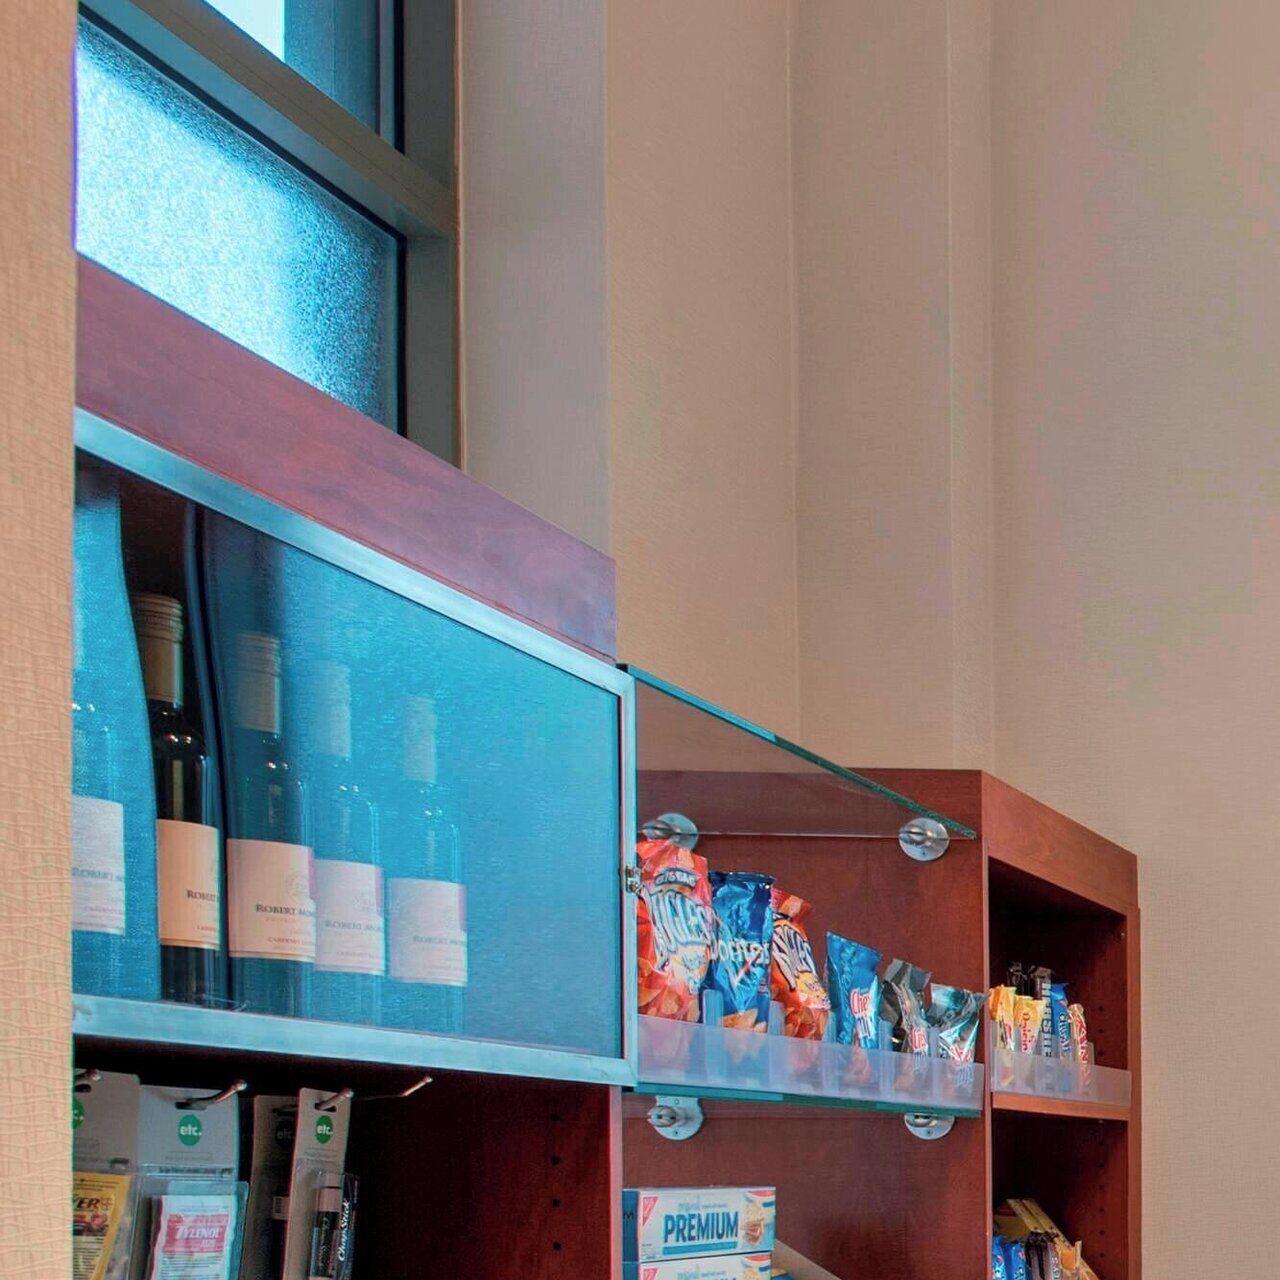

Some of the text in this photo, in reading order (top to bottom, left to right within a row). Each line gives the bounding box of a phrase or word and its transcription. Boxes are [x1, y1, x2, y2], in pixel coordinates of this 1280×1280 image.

[180, 1122, 202, 1137] etc.
[316, 1123, 334, 1135] etc.
[337, 1200, 351, 1262] ChapStick
[663, 1211, 739, 1243] PREMIUM
